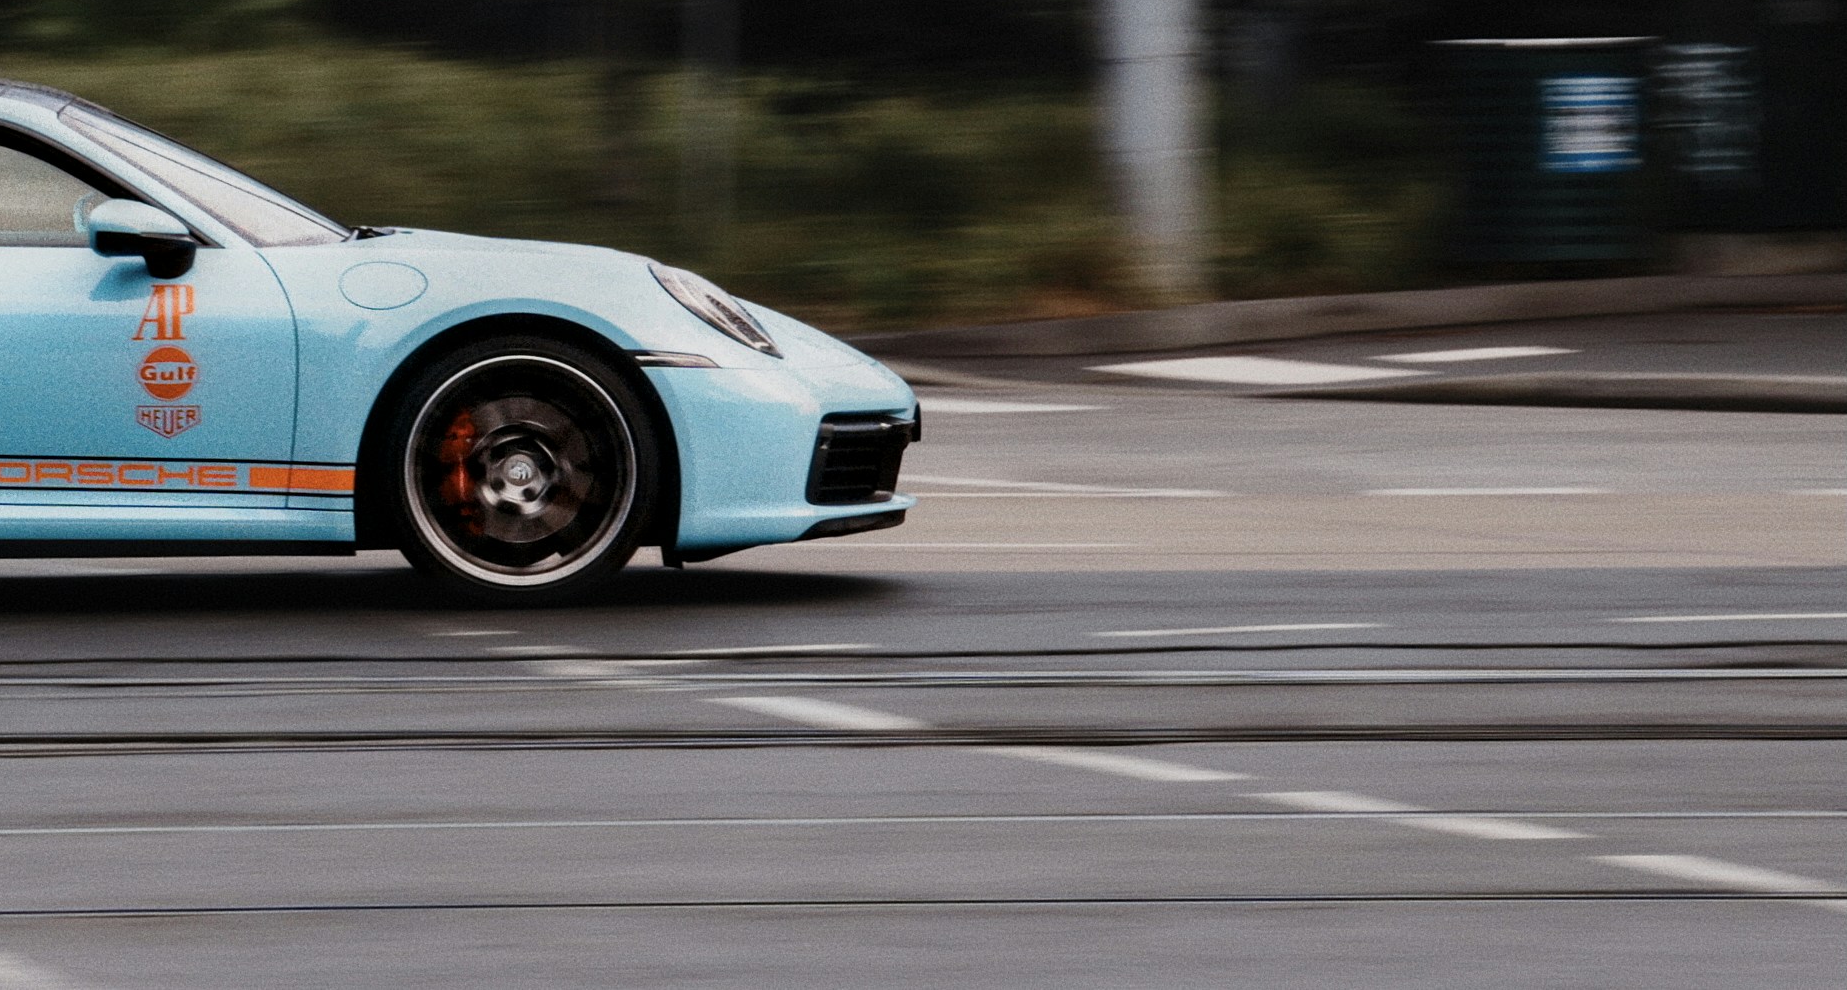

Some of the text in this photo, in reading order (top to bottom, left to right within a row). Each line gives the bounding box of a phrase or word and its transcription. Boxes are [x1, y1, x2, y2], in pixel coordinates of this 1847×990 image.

[131, 284, 196, 341] AP
[139, 364, 197, 381] Gulf
[140, 409, 197, 435] HEUER
